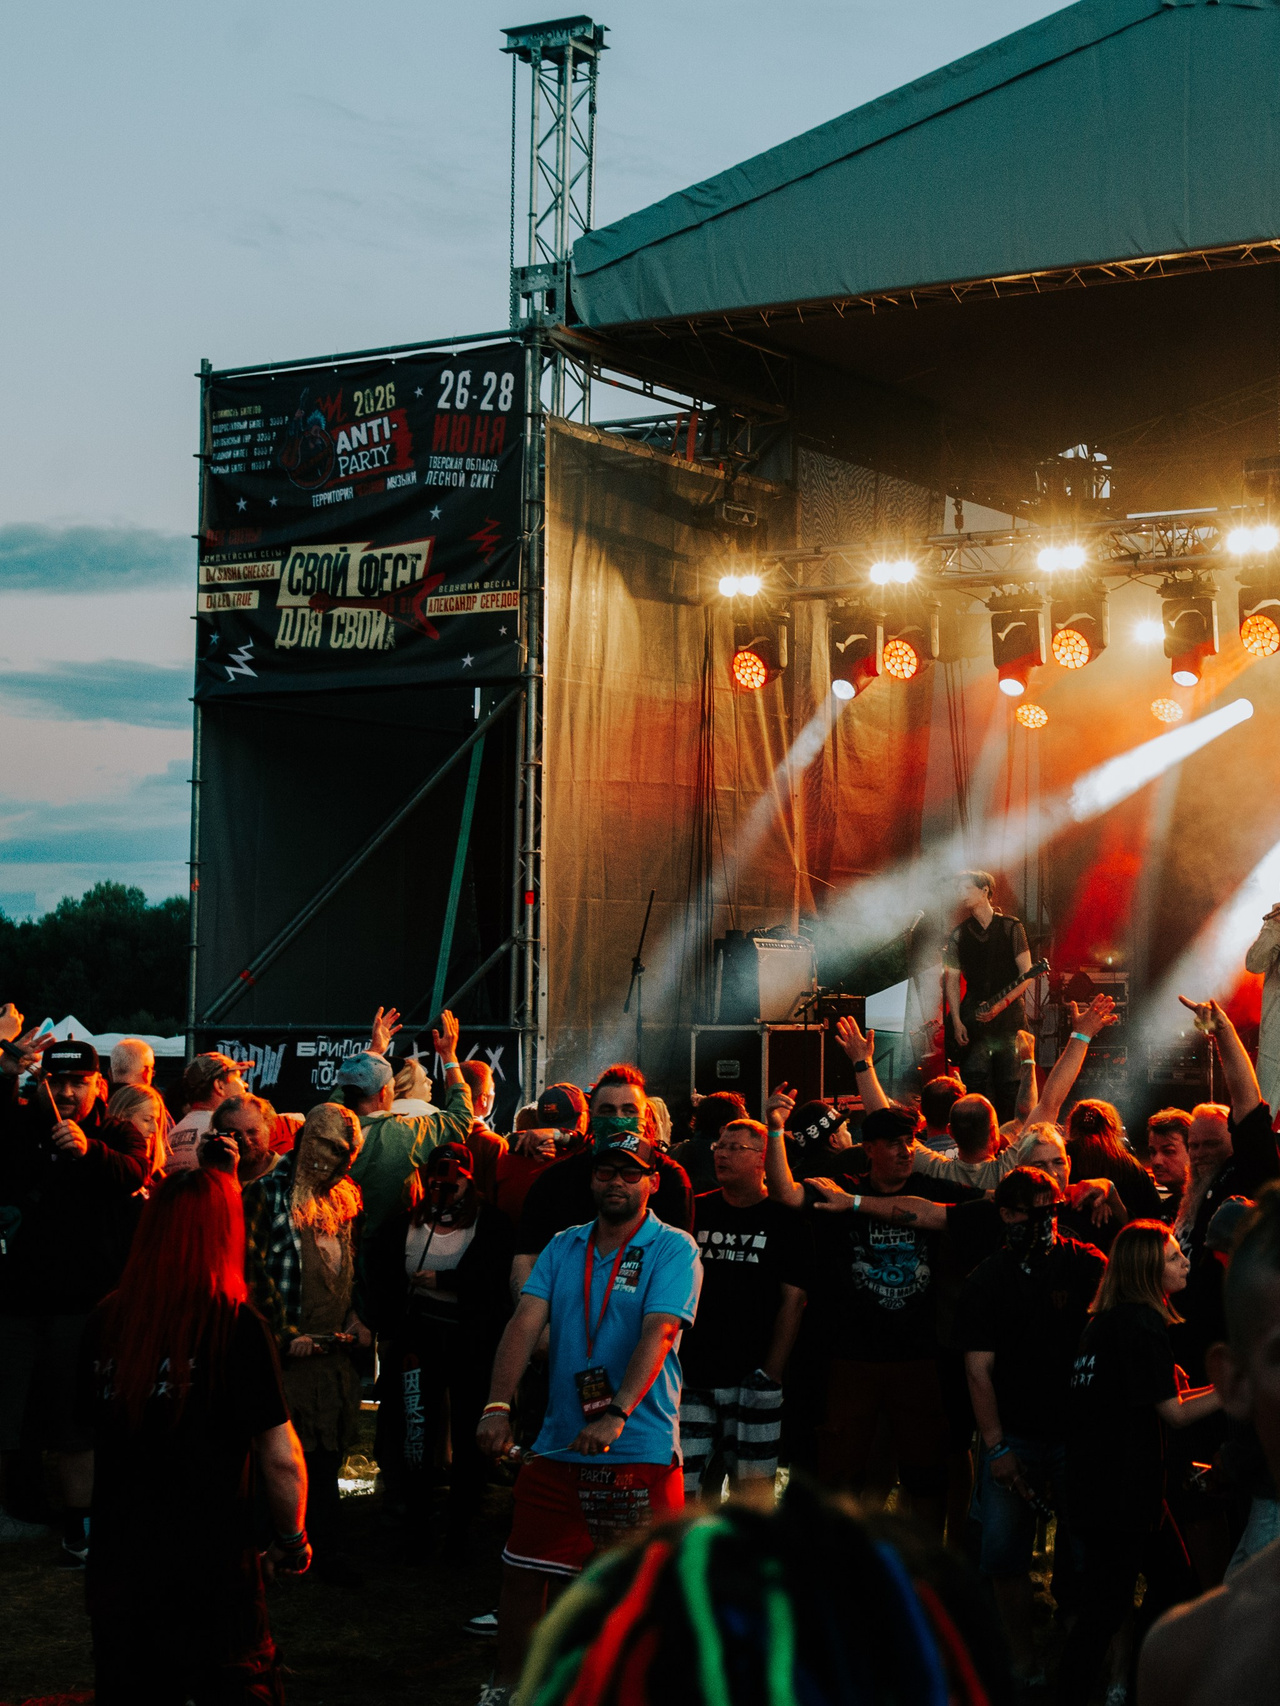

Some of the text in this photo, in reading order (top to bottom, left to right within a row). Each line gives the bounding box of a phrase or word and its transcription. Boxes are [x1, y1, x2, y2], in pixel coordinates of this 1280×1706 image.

[353, 381, 396, 417] 2026
[437, 369, 515, 412] 26-28
[336, 416, 398, 455] ANTI-
[432, 413, 507, 455] ИЮНЯ
[338, 444, 391, 478] PARTY
[428, 455, 464, 470] ТВЕРСКАЯ
[424, 470, 496, 490] ЛЕСНОЙ СКИТ
[243, 563, 275, 579] CHELSEA
[288, 547, 422, 598] СВОЙ ФЕСТ
[206, 595, 216, 609] DJ
[233, 592, 253, 607] TRUE
[428, 595, 477, 613] АЛЕКСАНДР
[275, 608, 323, 650] ДЛЯ
